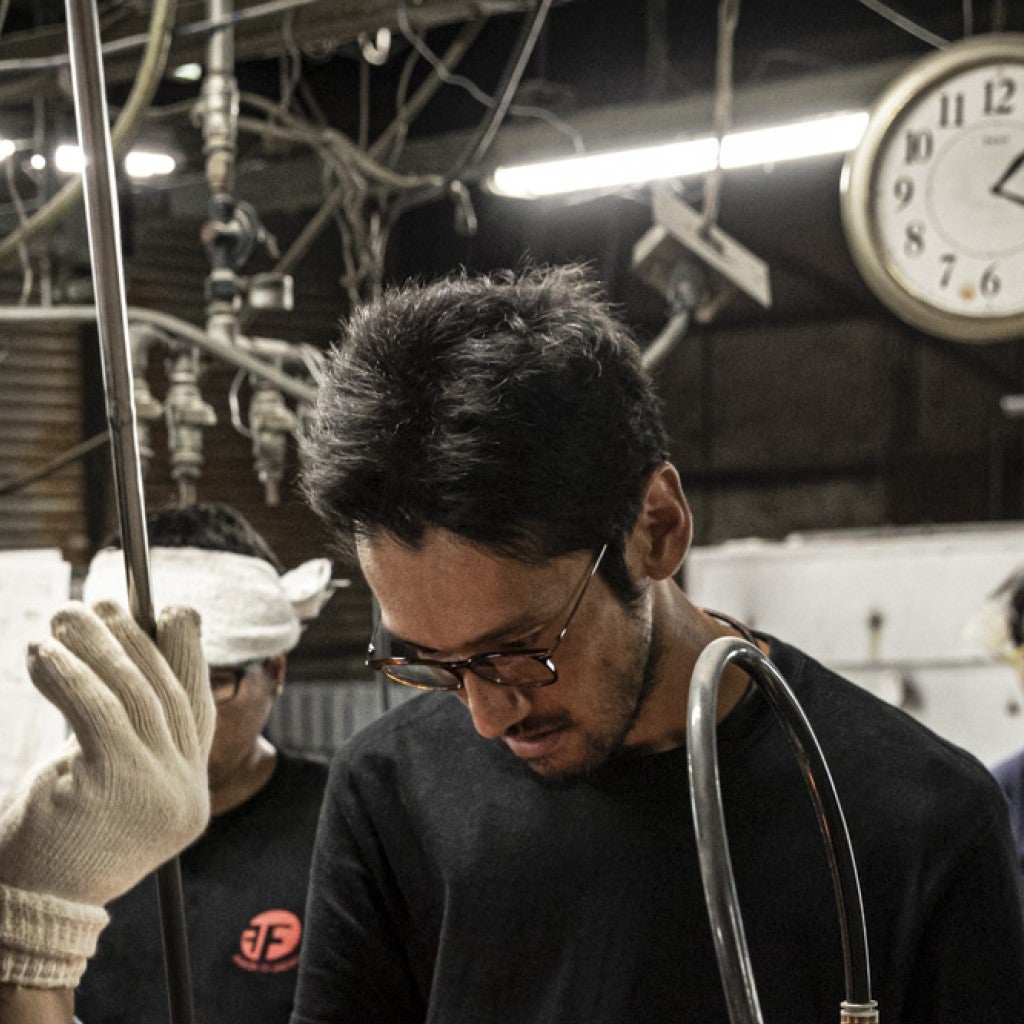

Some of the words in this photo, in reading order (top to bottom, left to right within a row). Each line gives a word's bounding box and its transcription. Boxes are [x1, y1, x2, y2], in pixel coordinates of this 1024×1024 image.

[939, 92, 964, 128] 11
[984, 79, 1016, 115] 12
[905, 130, 934, 165] 10
[894, 176, 914, 211] 9
[903, 221, 925, 258] 8
[938, 253, 957, 289] 7
[980, 261, 1001, 298] 6
